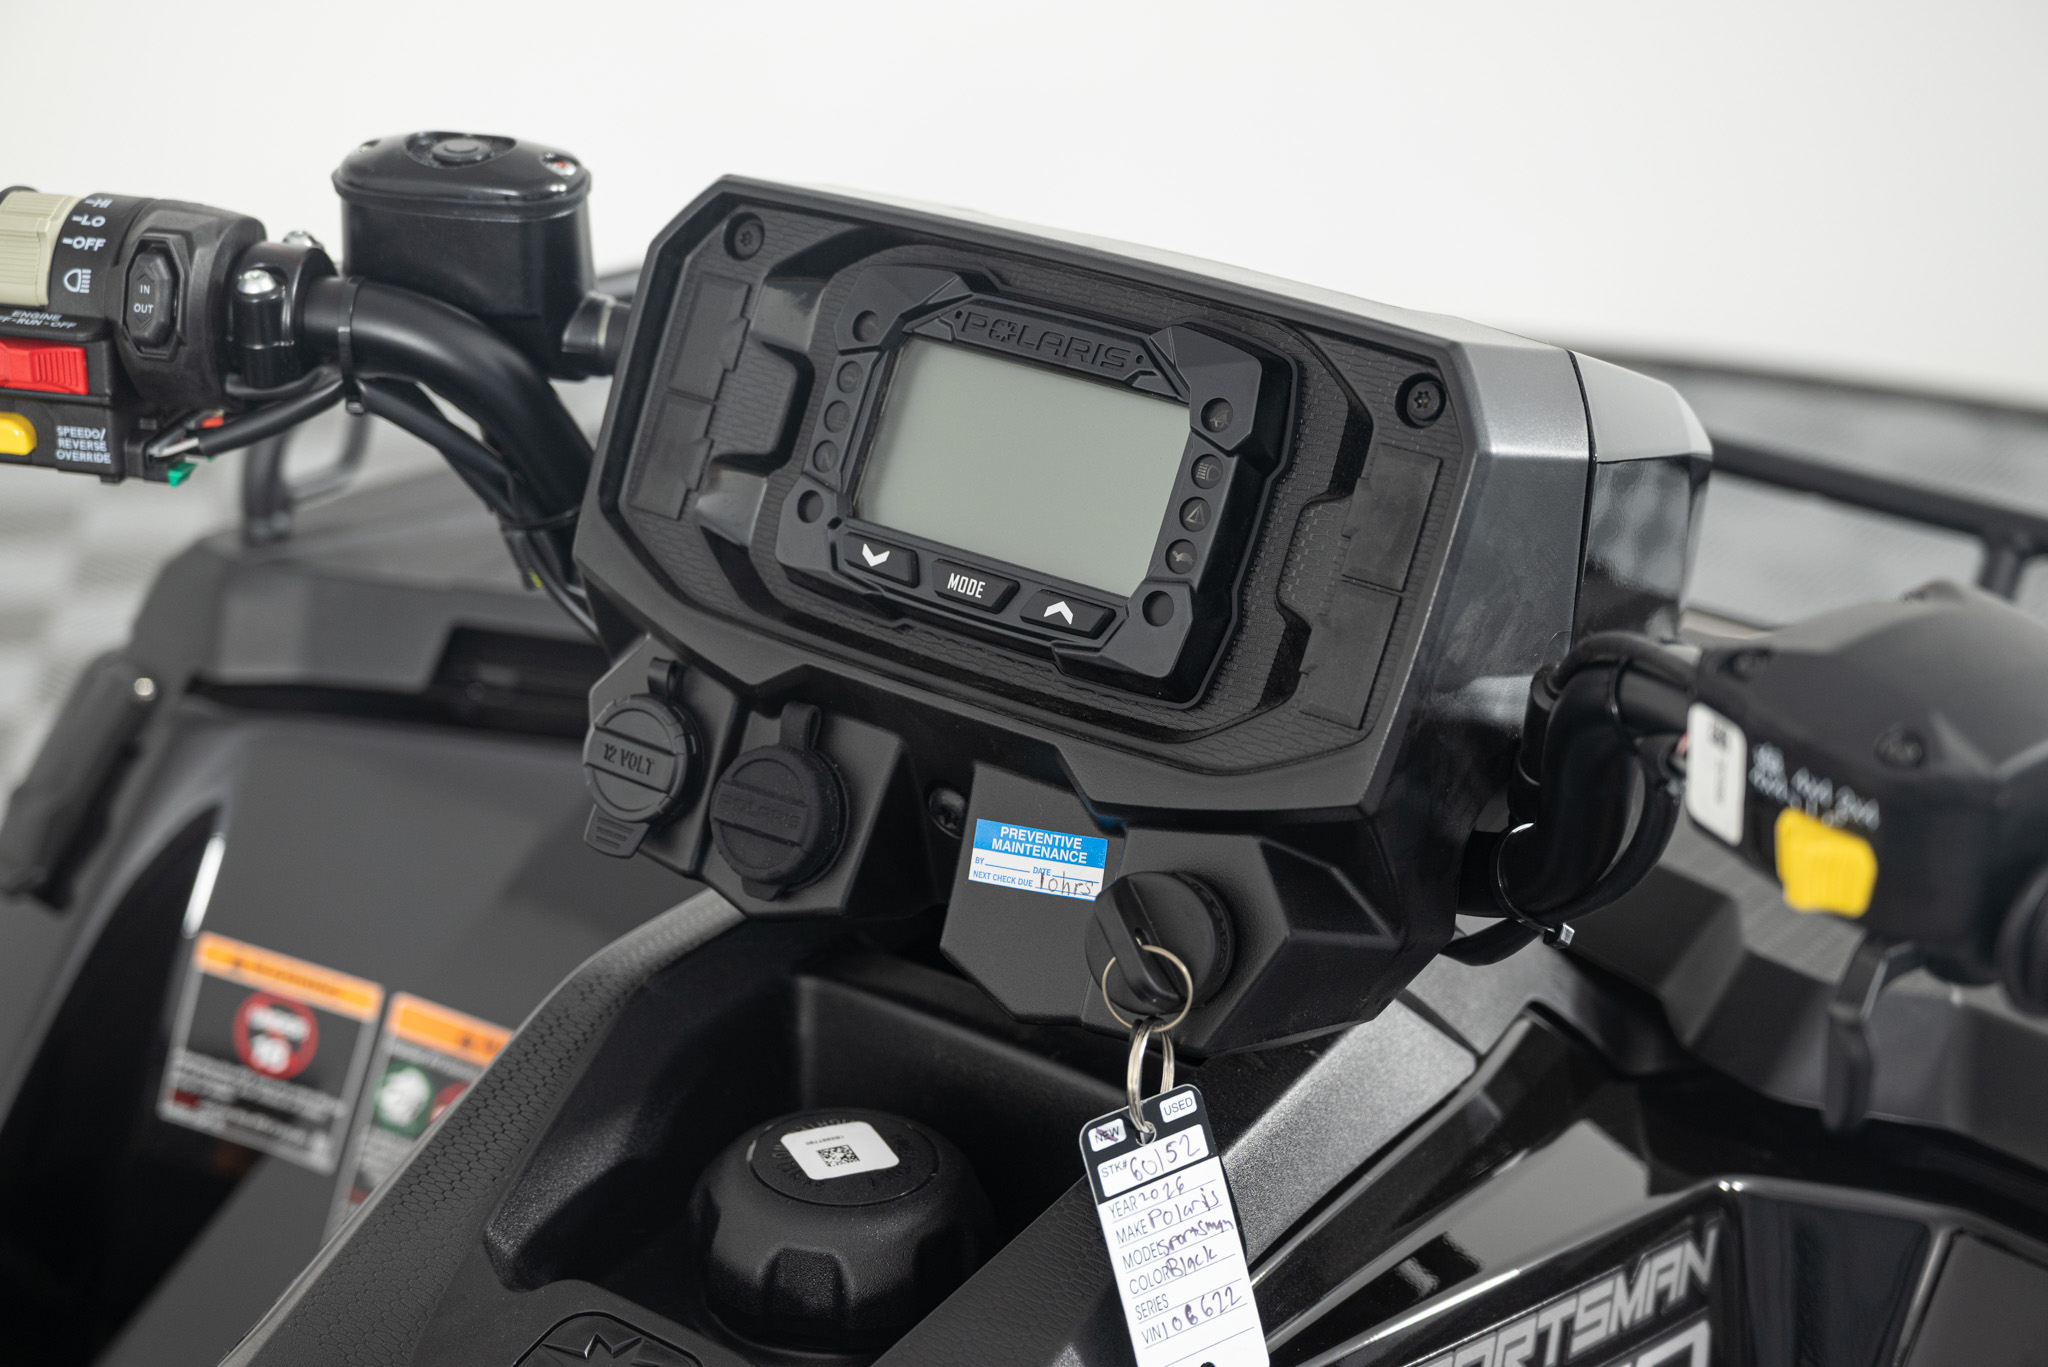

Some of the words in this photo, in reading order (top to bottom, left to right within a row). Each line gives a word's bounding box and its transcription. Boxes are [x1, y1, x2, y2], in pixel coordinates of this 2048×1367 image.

[140, 284, 150, 295] IN
[12, 310, 62, 321] ENGINE
[133, 302, 154, 314] OUT
[960, 311, 1132, 371] POLARIS
[56, 425, 106, 441] SPEEDO/
[57, 438, 107, 452] REVERSE
[56, 450, 111, 464] OVERRIDE
[947, 573, 986, 598] MODE
[604, 743, 617, 763] 12
[621, 748, 655, 776] VOLT
[1000, 826, 1083, 850] PREVENTIVE
[991, 838, 1088, 864] MAINTENANCE
[973, 870, 991, 881] NEXT
[992, 873, 1016, 885] CHECK
[1018, 878, 1033, 887] DUE
[975, 857, 985, 865] BY
[1033, 866, 1051, 876] DATE
[1095, 1126, 1120, 1143] NEW
[1164, 1097, 1193, 1116] USED
[1101, 1160, 1128, 1178] STK#
[1108, 1195, 1138, 1219] YEAR
[1138, 1175, 1184, 1201] 2026
[1115, 1219, 1148, 1245] MAKE
[1148, 1188, 1219, 1229] Polaris
[1122, 1241, 1163, 1270] MODEL
[1129, 1264, 1170, 1295] COLOR
[1134, 1293, 1169, 1320] SERIES
[1141, 1324, 1162, 1344] VIN
